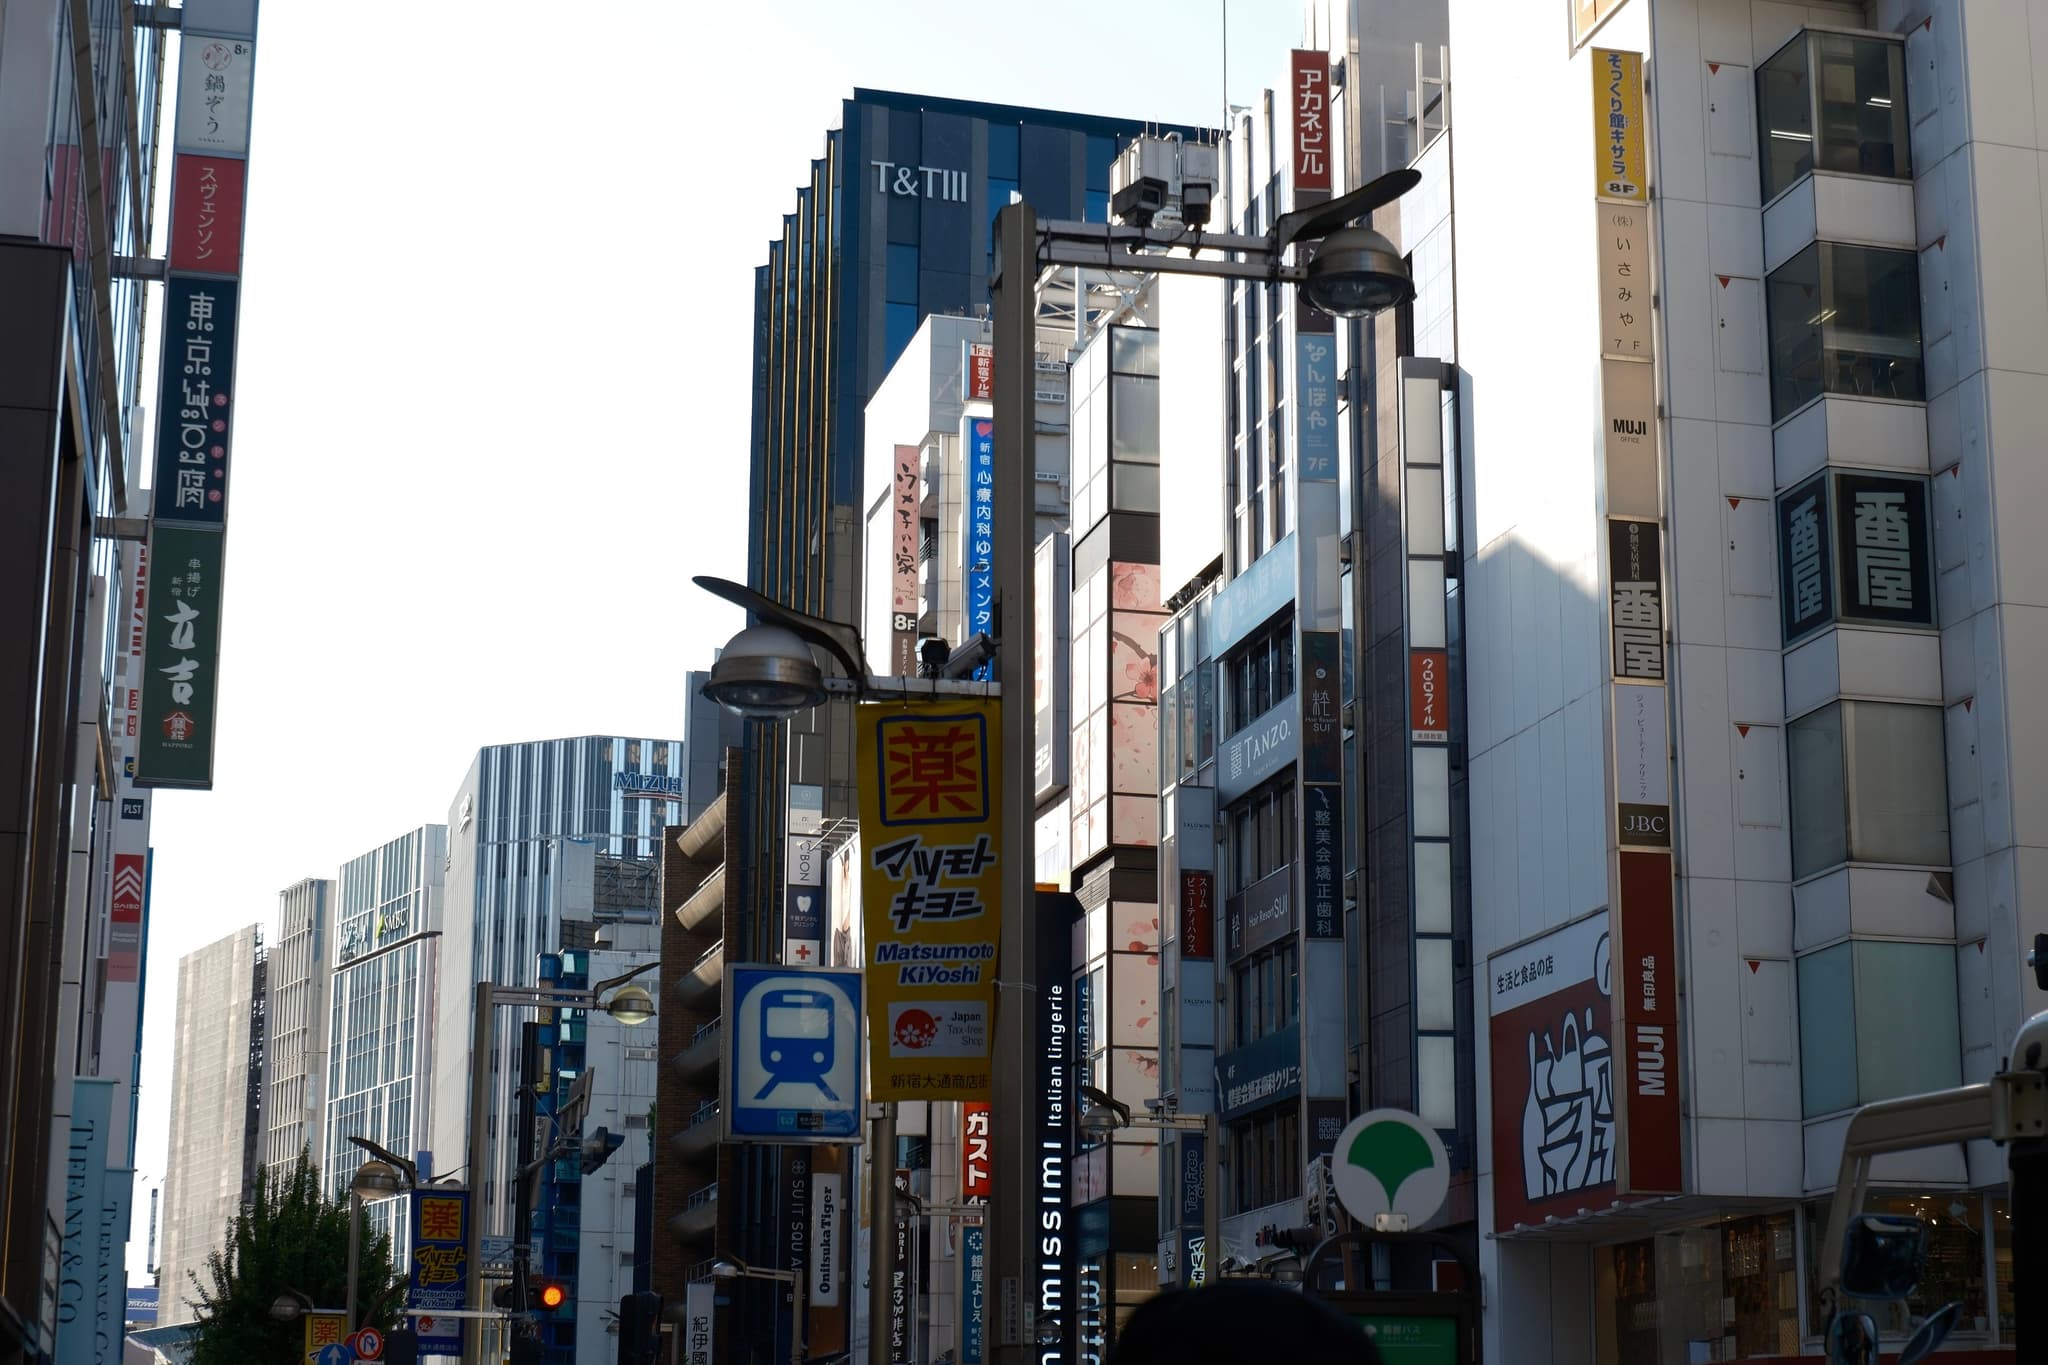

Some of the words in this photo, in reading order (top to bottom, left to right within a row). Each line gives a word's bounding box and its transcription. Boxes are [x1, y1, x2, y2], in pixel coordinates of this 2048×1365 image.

[234, 44, 249, 55] 8F
[204, 73, 225, 135] 鍋ぞう
[1299, 69, 1323, 175] アカネビル
[1608, 53, 1626, 176] そっくり館キサラ
[1609, 182, 1635, 194] 8F
[195, 167, 218, 261] スヴェンソン
[1616, 236, 1634, 327] いさみや
[175, 291, 215, 510] 東京純豆腐
[1305, 342, 1328, 431] なんぼや
[1613, 417, 1647, 436] MUJI
[979, 442, 990, 465] 新宿
[1308, 457, 1329, 471] 7F
[1789, 494, 1823, 624] 番屋
[1854, 492, 1913, 610] 番屋
[894, 614, 916, 631] 8F
[1614, 581, 1662, 677] 番屋
[1312, 723, 1331, 733] SUI
[888, 727, 978, 816] 薬
[123, 803, 142, 815] PLST
[1623, 815, 1665, 833] JBC
[872, 837, 996, 889] マツモト
[1314, 810, 1332, 936] 整美会矯正歯科
[113, 902, 140, 910] DAISO
[892, 890, 984, 933] キヨシ
[1199, 878, 1208, 909] スリム
[1274, 896, 1288, 920] SUI
[382, 907, 408, 934] SMBC
[876, 941, 994, 963] Matsumoto
[900, 964, 981, 987] KiYoshi
[1496, 955, 1554, 995] 生活と食品の店
[1642, 955, 1657, 1012] 無印良品
[951, 1011, 982, 1022] Japan
[1048, 984, 1066, 1059] lingerie
[961, 1035, 984, 1047] Shop
[1636, 1025, 1666, 1097] MUJI
[890, 1072, 988, 1089] 新宿大通商店街
[1048, 1064, 1063, 1127] Italian
[966, 1111, 990, 1188] ガスト
[1184, 1150, 1198, 1182] Free
[820, 1186, 833, 1228] Tiger
[1184, 1179, 1197, 1214] Tax
[424, 1201, 458, 1238] 薬
[416, 1247, 465, 1267] マツモト
[819, 1227, 833, 1295] Onitsuka
[413, 1290, 464, 1299] Matsumoto
[970, 1254, 984, 1323] 銀座よしえ
[314, 1320, 337, 1344] 薬
